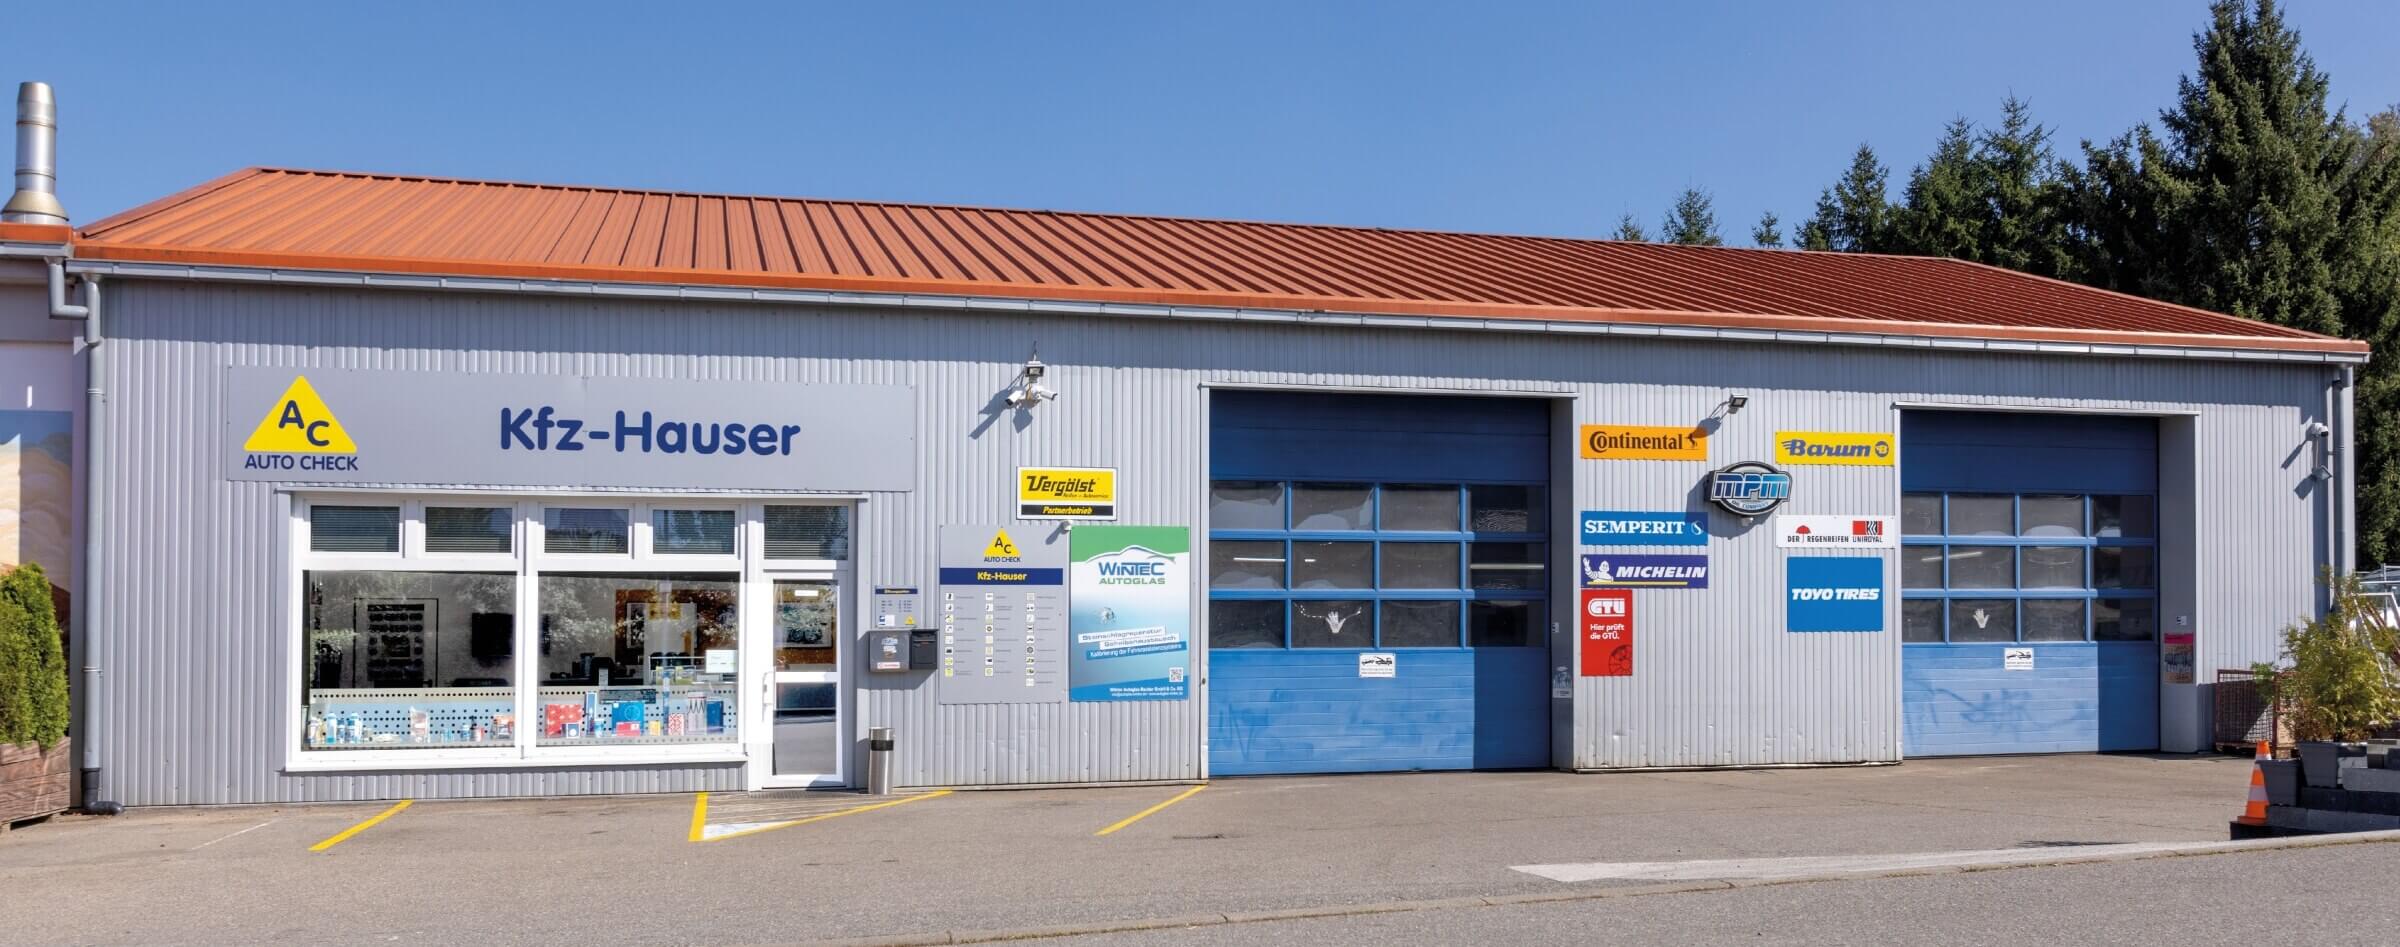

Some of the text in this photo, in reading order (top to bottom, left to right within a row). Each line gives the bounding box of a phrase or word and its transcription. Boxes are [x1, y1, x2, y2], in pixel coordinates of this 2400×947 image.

[501, 406, 801, 456] Kfz-Hauser
[1589, 431, 1683, 453] Continental
[1781, 439, 1872, 457] Barum
[244, 454, 359, 471] AUTO CHECK
[1026, 475, 1097, 497] Vergölst
[1042, 506, 1093, 515] Partnerbetrieb
[1584, 520, 1686, 534] SEMPERIT
[1787, 535, 1883, 543] DER REGENREIFEN UNIROYAL
[977, 571, 1028, 581] Kfz-Hauser
[1616, 566, 1707, 578] MICHELIN
[1098, 577, 1166, 585] AUTOGLAS
[1791, 588, 1880, 601] TOYO TIRES
[1606, 623, 1625, 632] prüft
[1590, 632, 1600, 640] die
